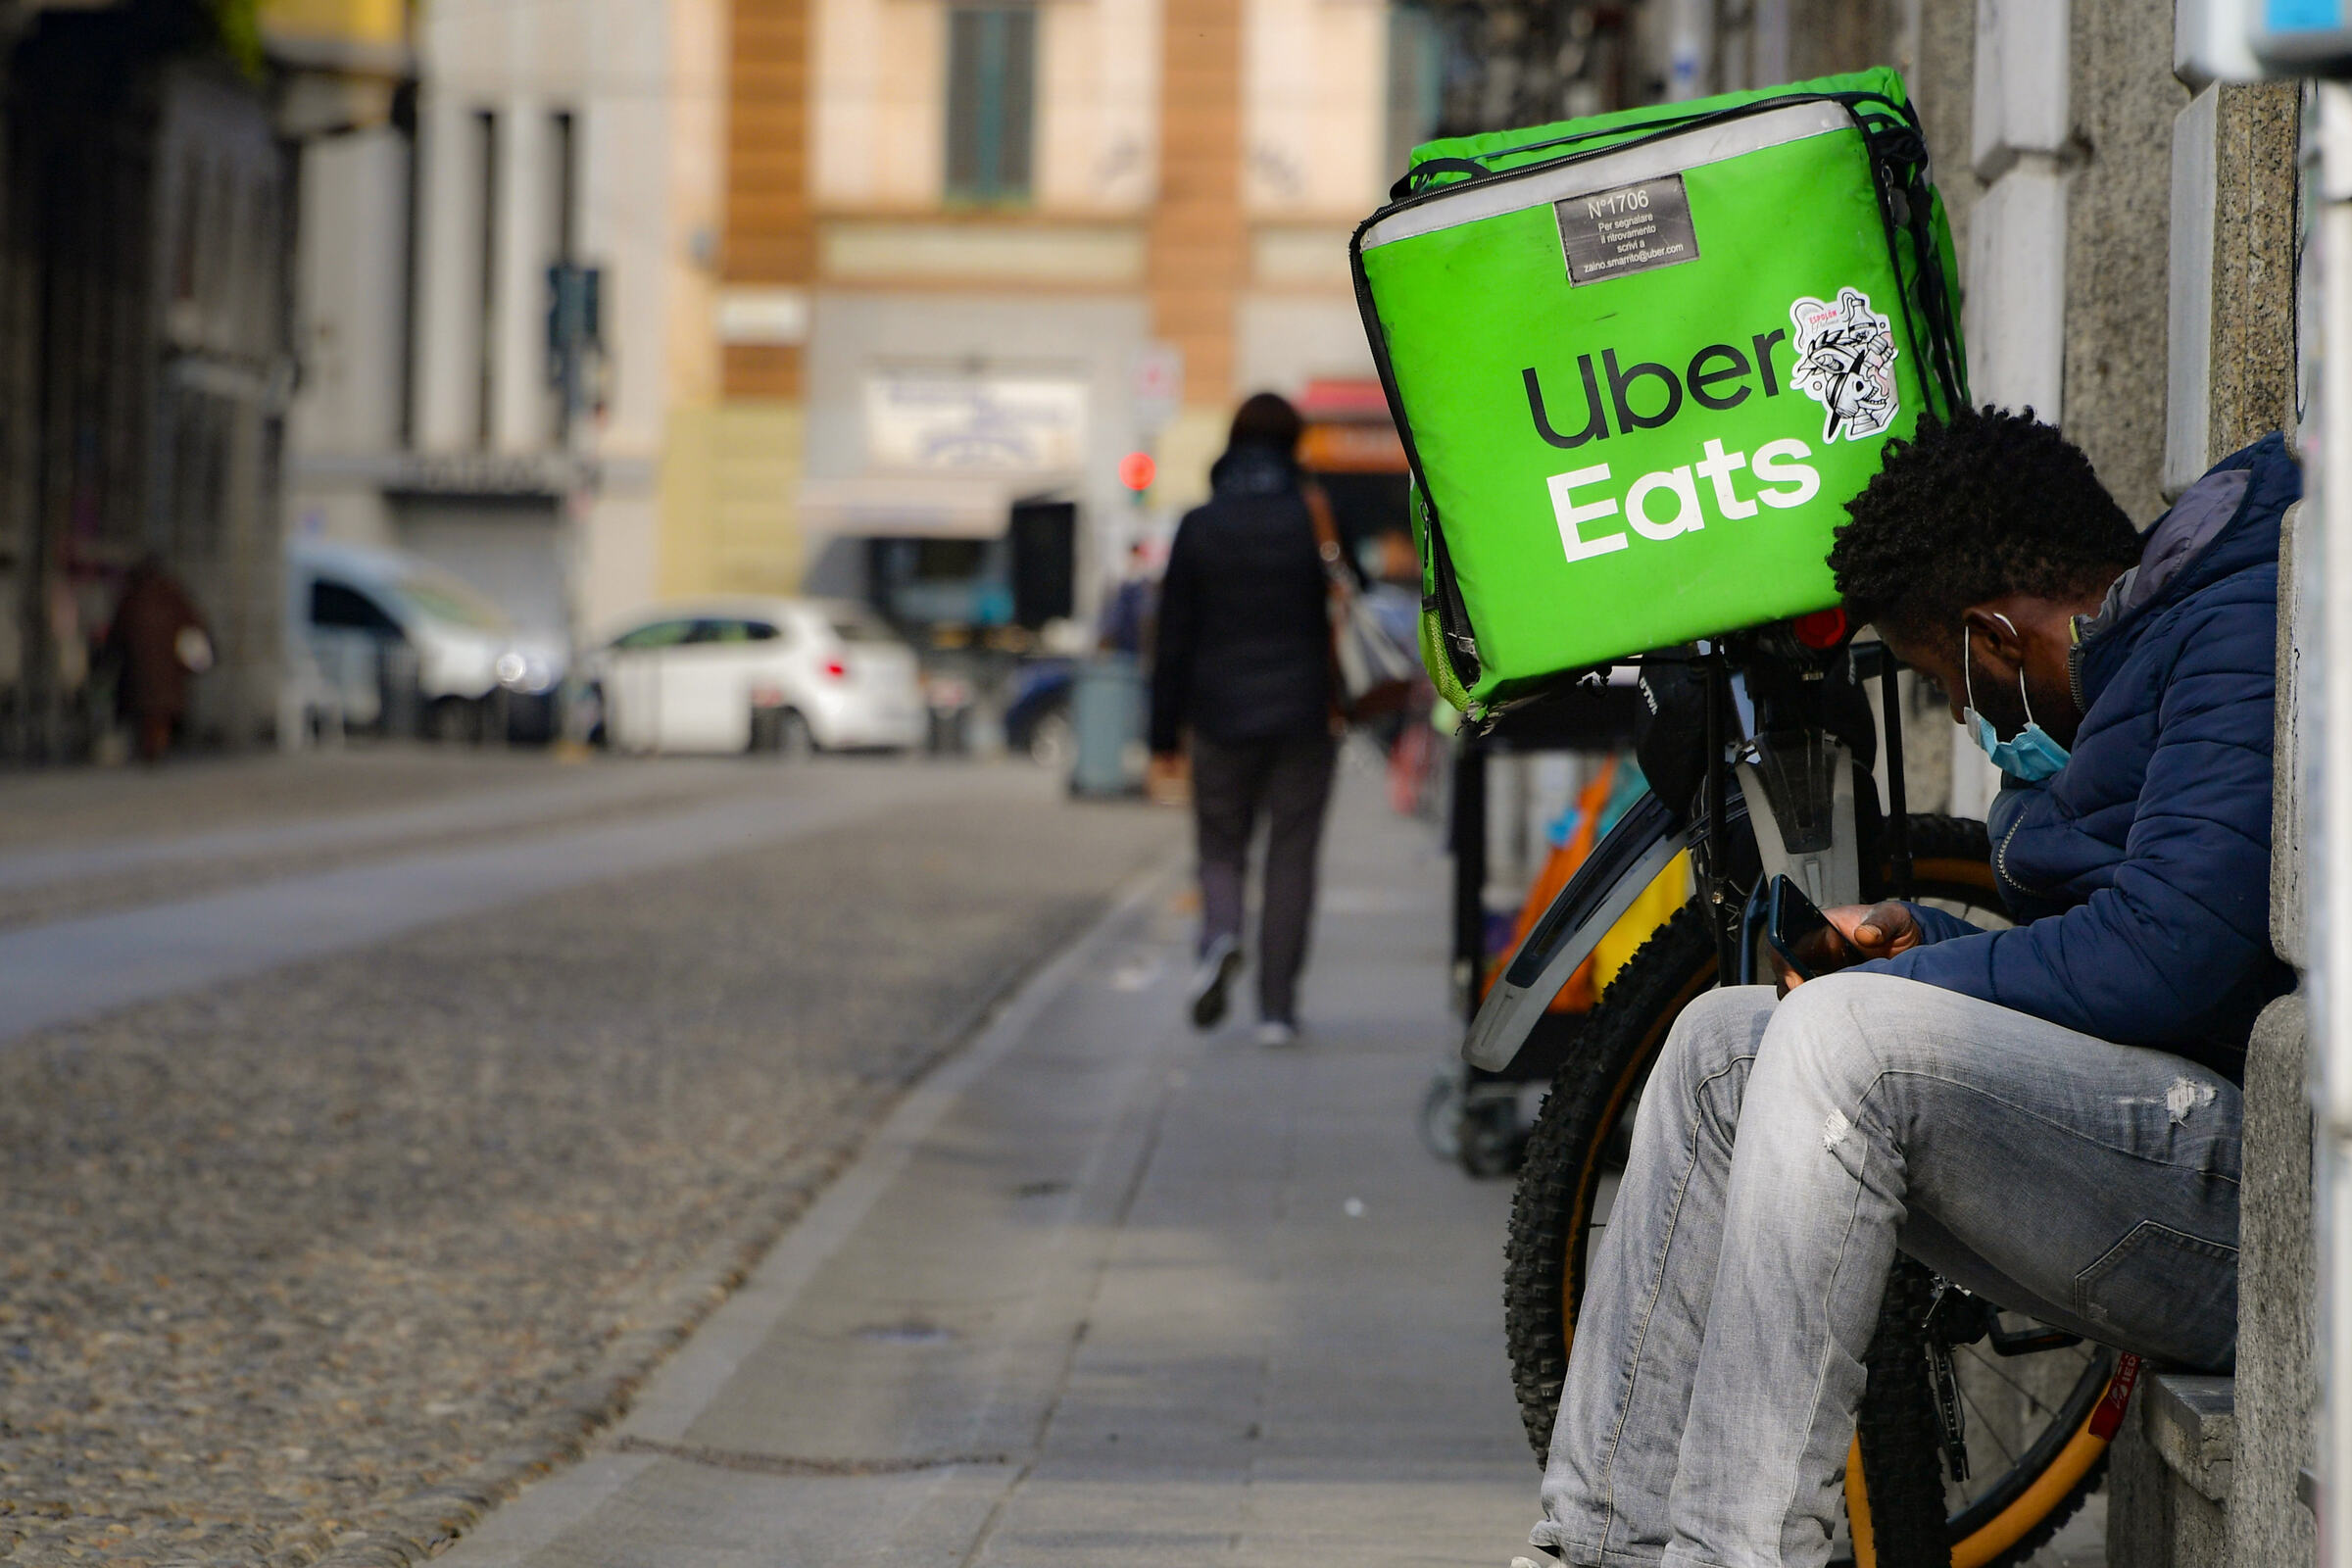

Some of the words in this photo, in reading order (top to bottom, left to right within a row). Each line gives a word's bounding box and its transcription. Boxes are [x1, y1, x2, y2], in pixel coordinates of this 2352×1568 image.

[1588, 190, 1649, 220] N°1706
[1598, 221, 1612, 232] Per
[1614, 213, 1653, 229] segnalare
[1600, 234, 1606, 244] il
[1607, 224, 1656, 243] ritrovamento
[1584, 243, 1684, 273] zaino.smarrito@uber.com
[1617, 242, 1638, 253] scrivi
[1522, 328, 1786, 449] Uber
[1546, 438, 1821, 563] Eats
